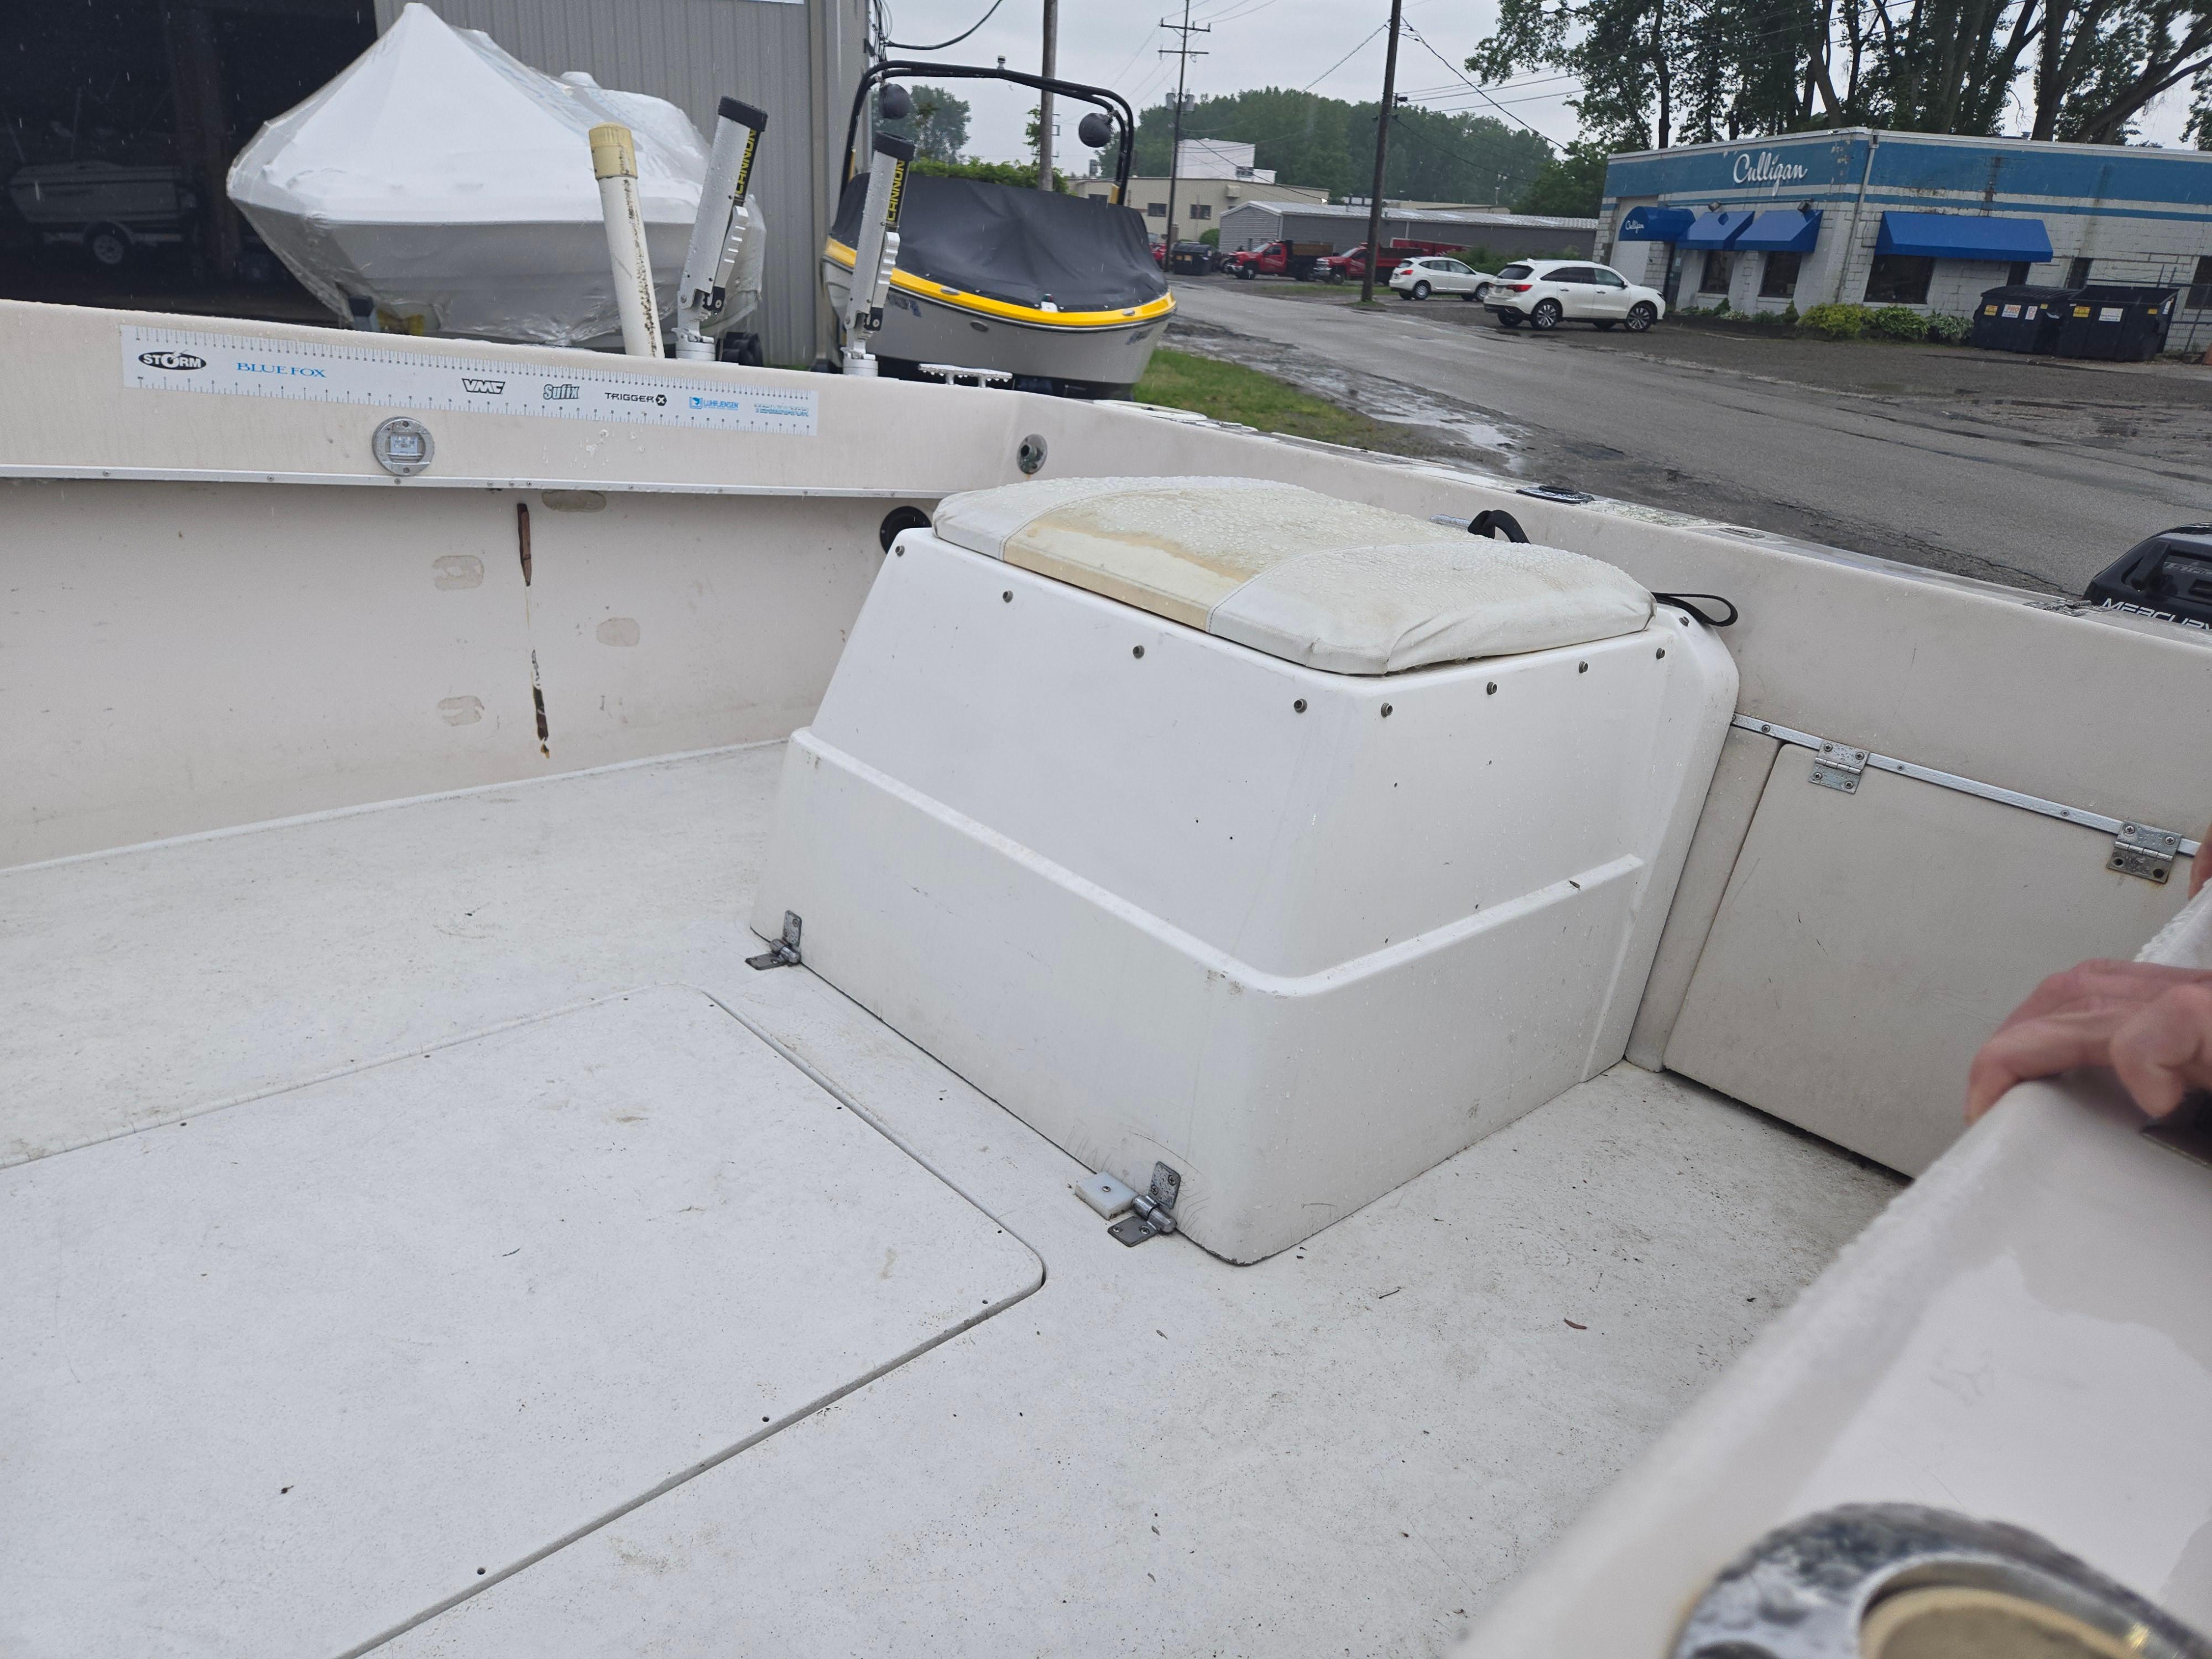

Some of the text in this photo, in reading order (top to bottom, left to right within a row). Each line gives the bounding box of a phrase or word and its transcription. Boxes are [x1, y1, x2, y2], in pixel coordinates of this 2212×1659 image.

[735, 128, 757, 195] CANNON
[1733, 152, 1808, 196] Culligan
[886, 159, 905, 221] CANNON
[143, 351, 202, 368] STORM
[237, 362, 326, 378] BLUE FOX
[543, 384, 580, 400] Sufix
[604, 392, 654, 403] TRIGGER
[2102, 598, 2212, 630] MERCR
